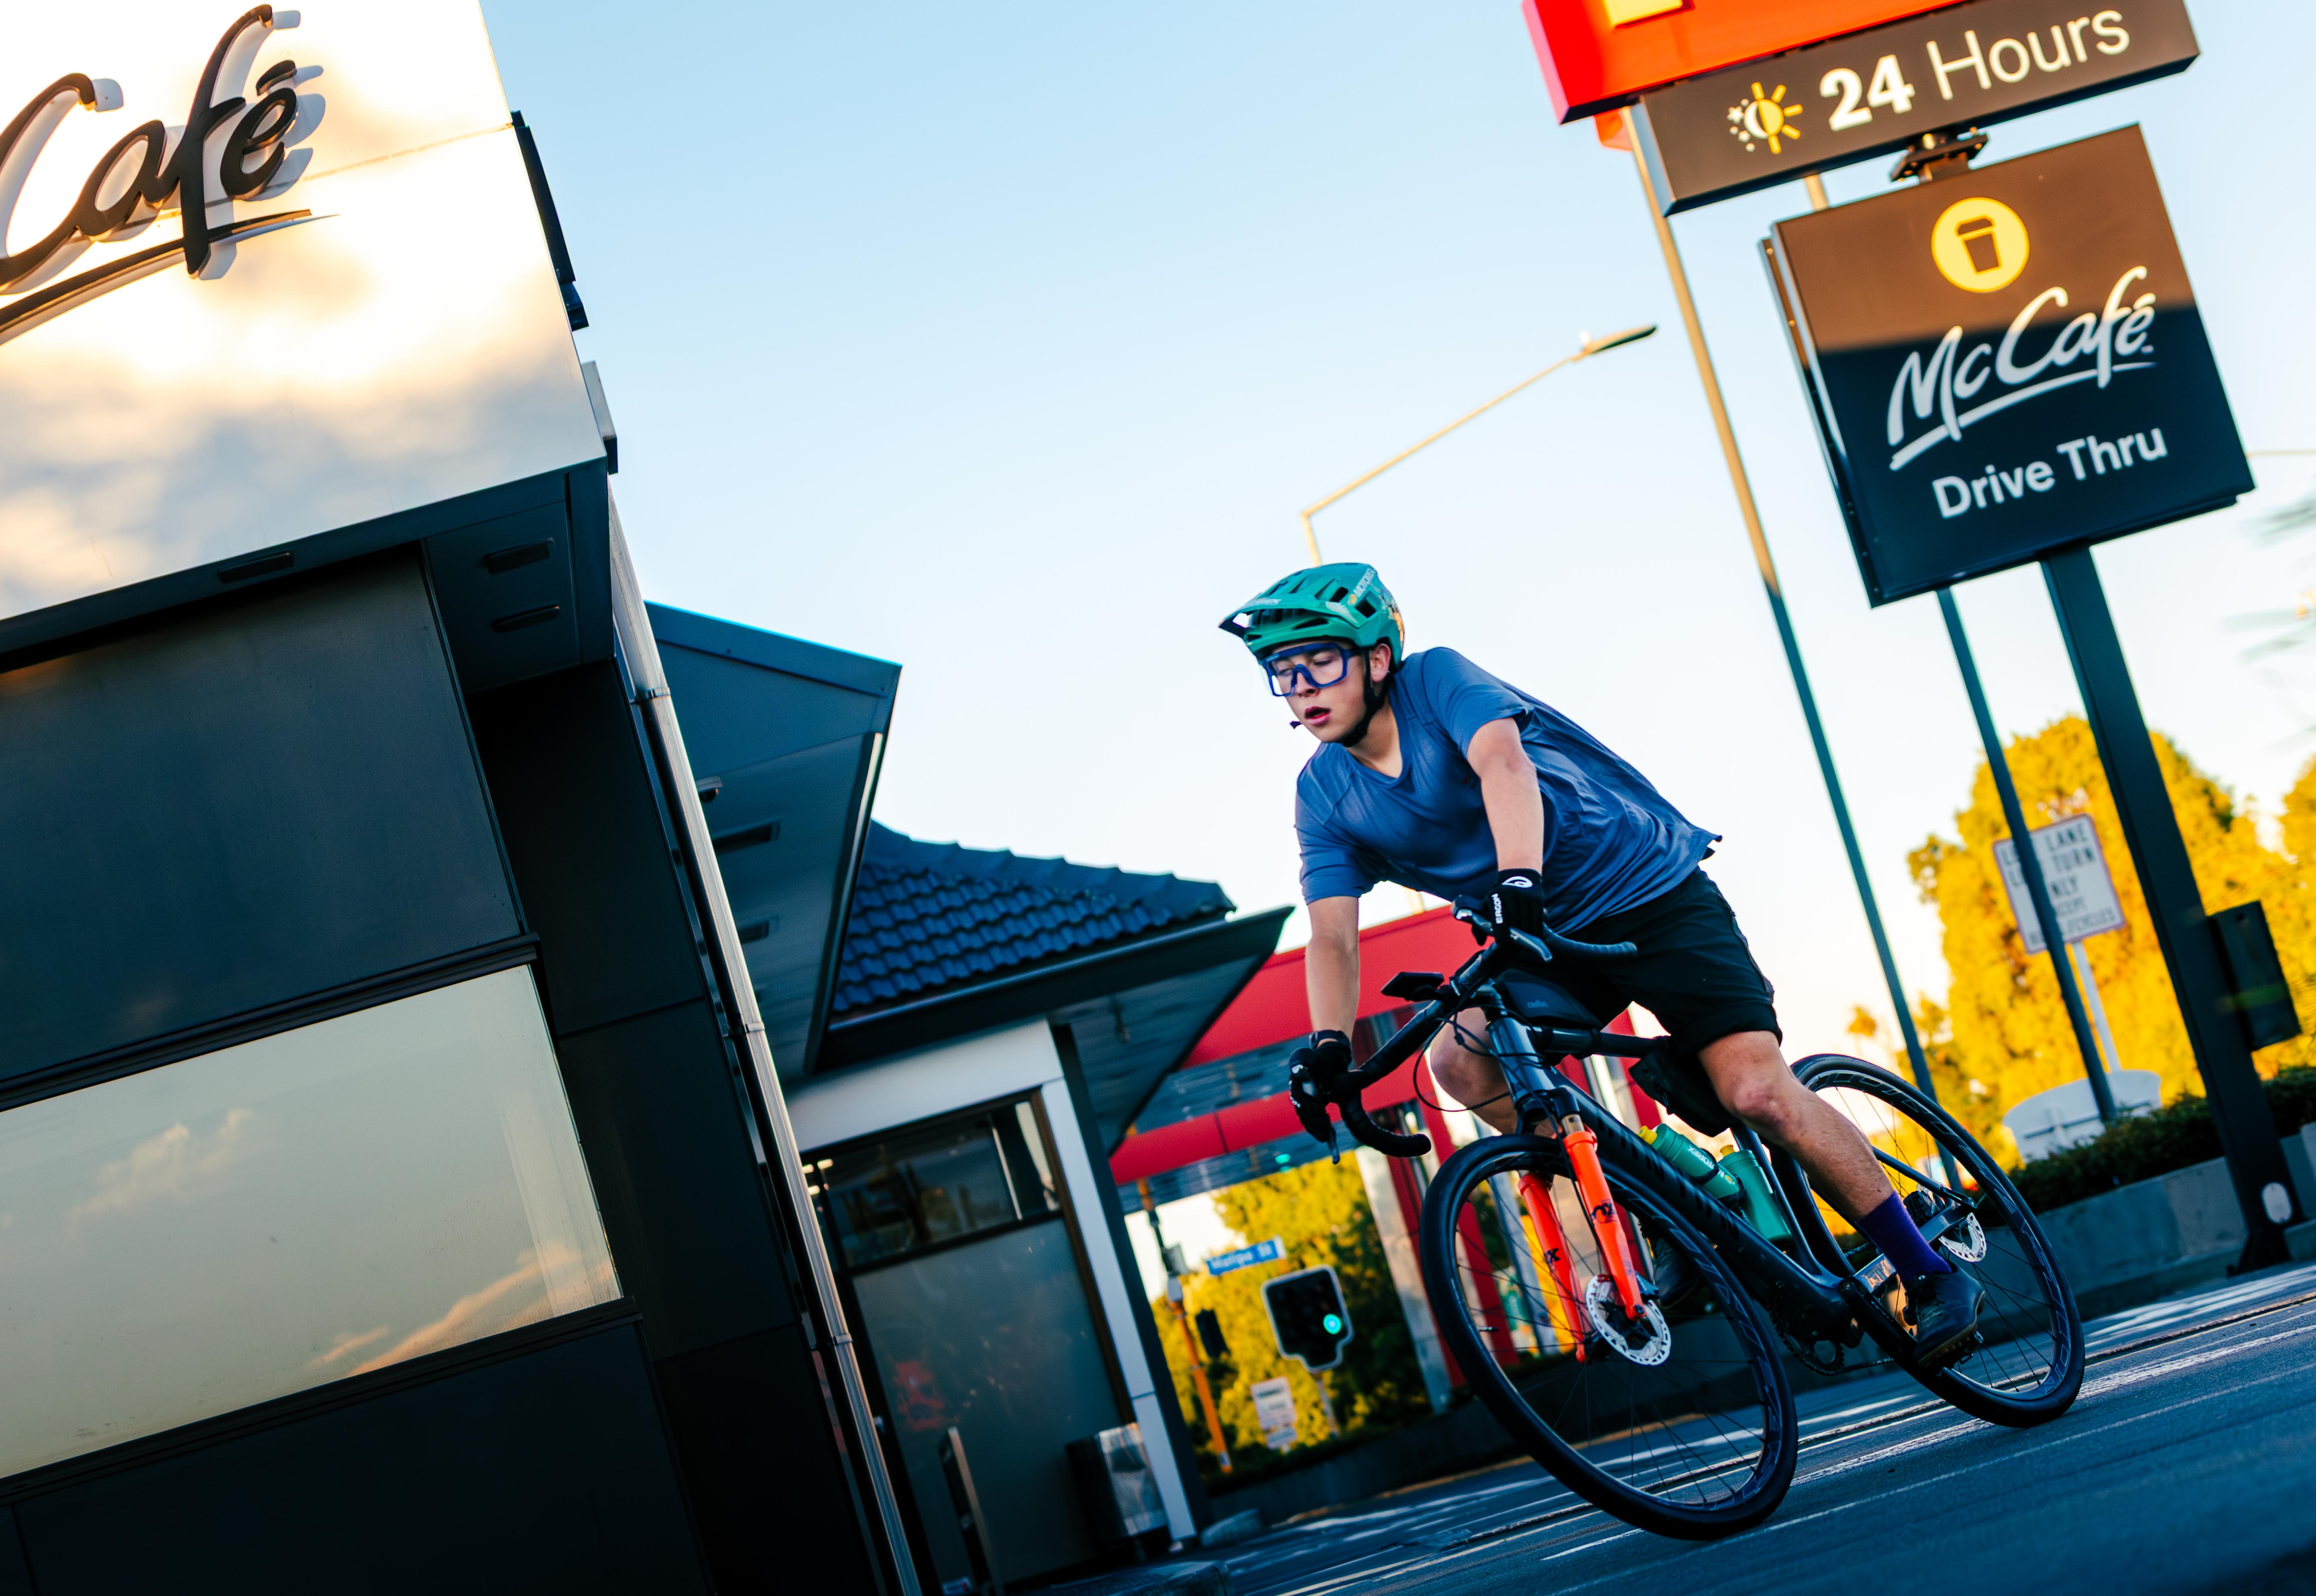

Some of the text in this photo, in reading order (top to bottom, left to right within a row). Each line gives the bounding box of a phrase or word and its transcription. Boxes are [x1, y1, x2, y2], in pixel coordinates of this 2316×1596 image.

[1819, 9, 2131, 132] 24 Hours
[0, 4, 298, 279] Café
[1887, 265, 2156, 446] McCafé
[1932, 427, 2168, 519] Drive Thru
[2044, 823, 2087, 852] LANE
[1492, 893, 1504, 924] ERGON
[1688, 1144, 1725, 1178] MTOREX
